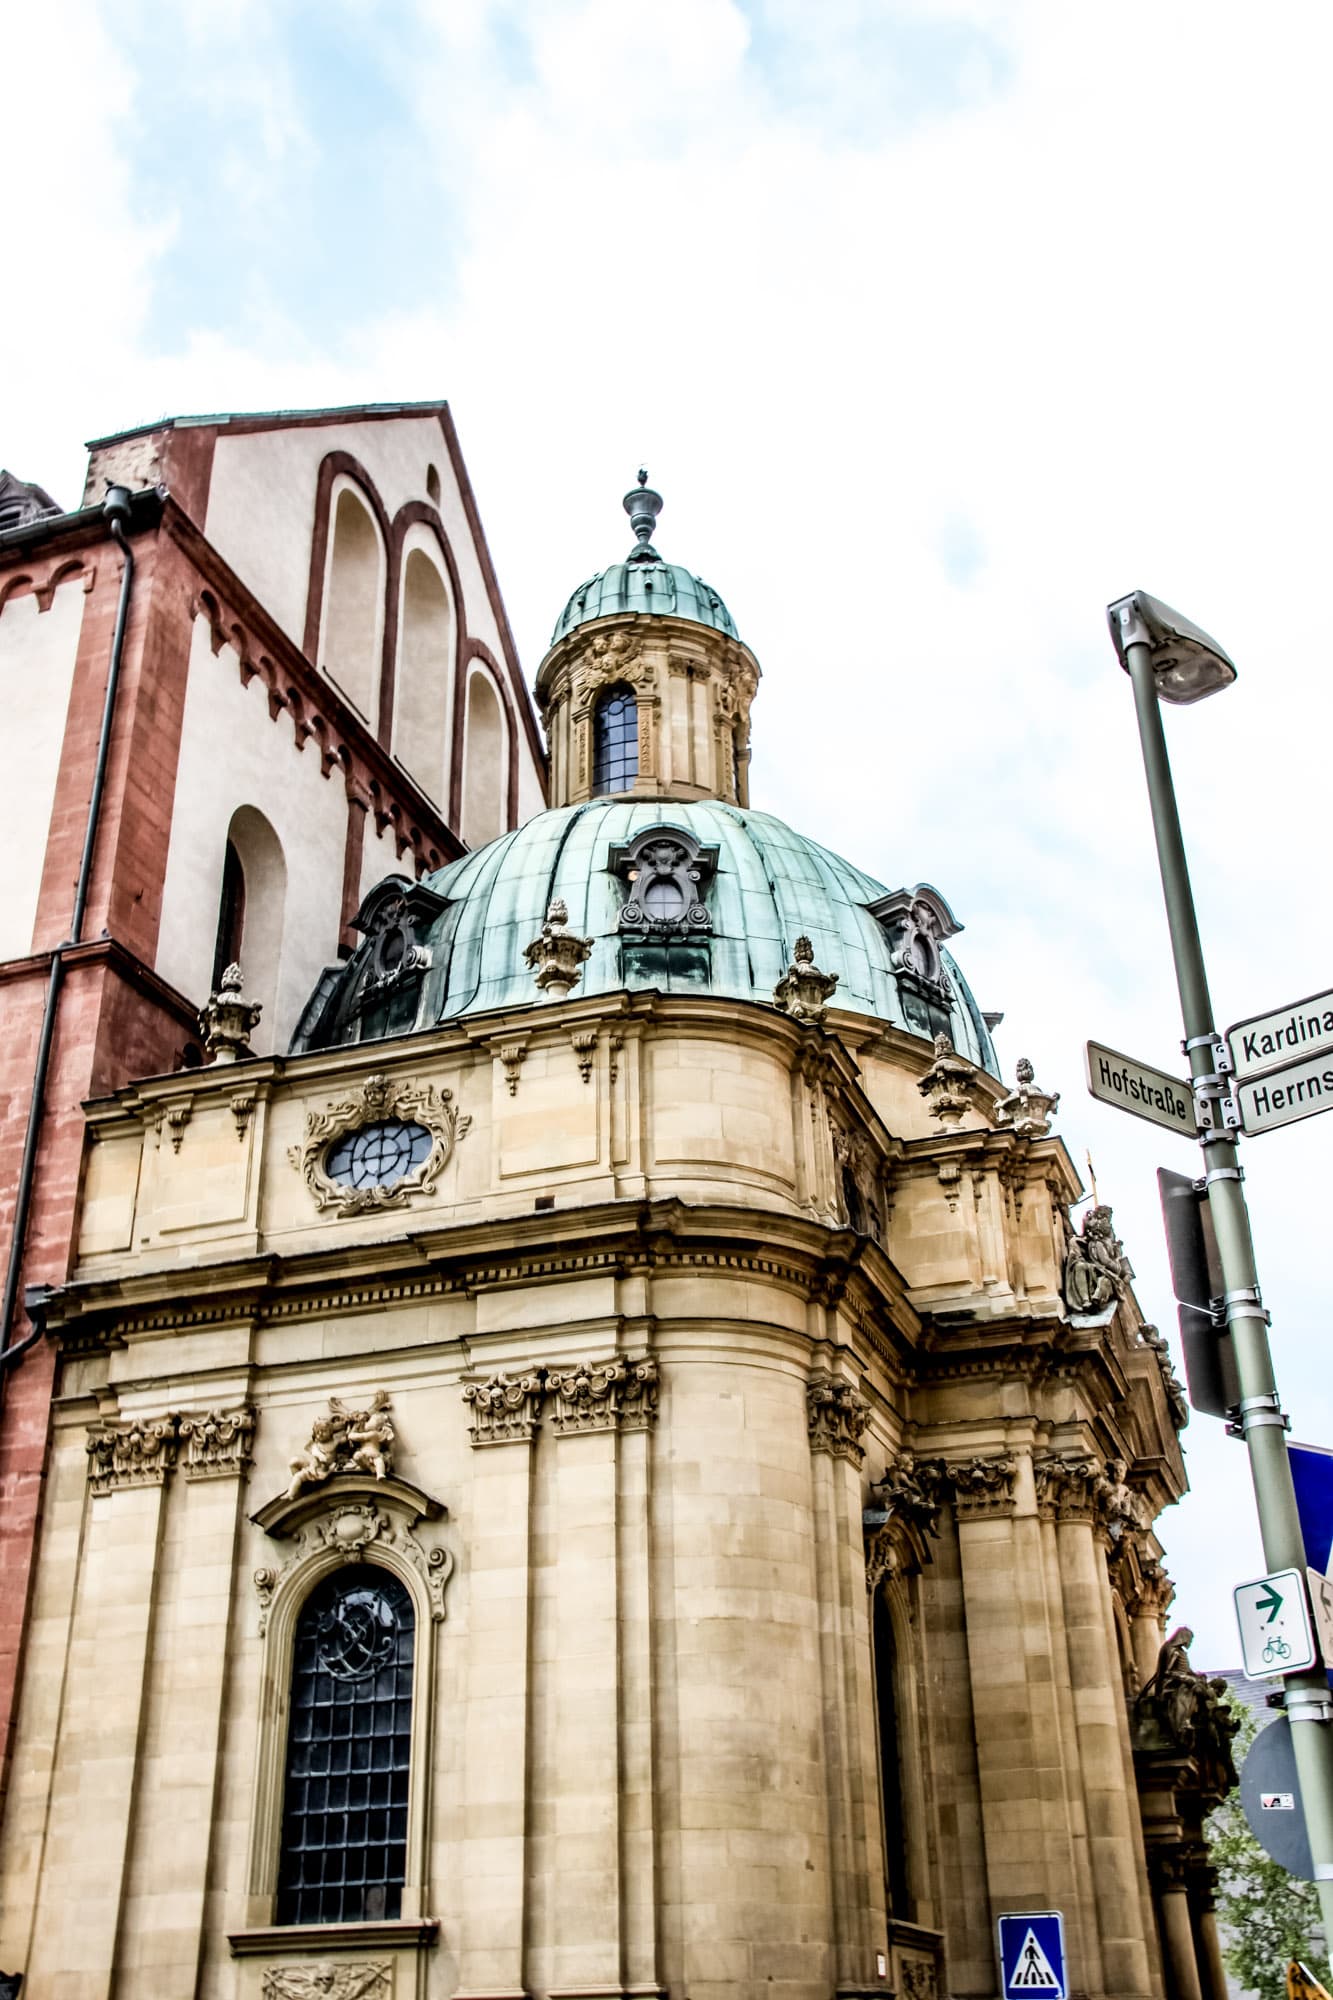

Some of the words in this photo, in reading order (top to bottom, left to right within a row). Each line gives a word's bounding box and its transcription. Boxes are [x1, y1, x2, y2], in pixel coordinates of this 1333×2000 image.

[1243, 1011, 1333, 1062] Kardina
[1099, 1058, 1186, 1120] Hofstraße
[1253, 1070, 1333, 1116] Herrns
